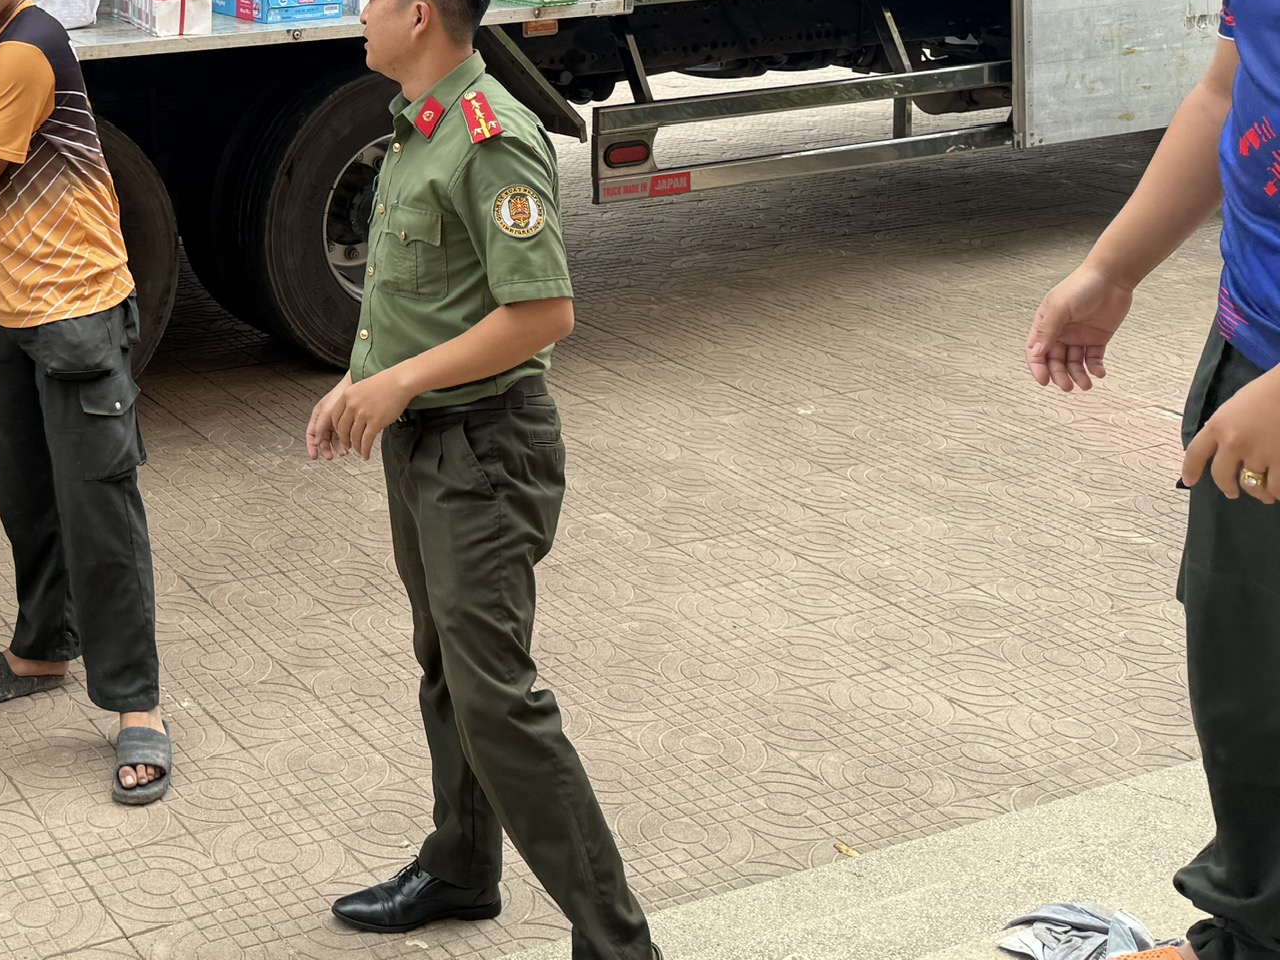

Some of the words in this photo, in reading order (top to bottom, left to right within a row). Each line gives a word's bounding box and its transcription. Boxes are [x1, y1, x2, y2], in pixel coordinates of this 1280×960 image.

[602, 185, 623, 197] TRUCK
[623, 183, 640, 195] MADE
[640, 182, 647, 193] IN
[655, 177, 687, 190] JAPAN
